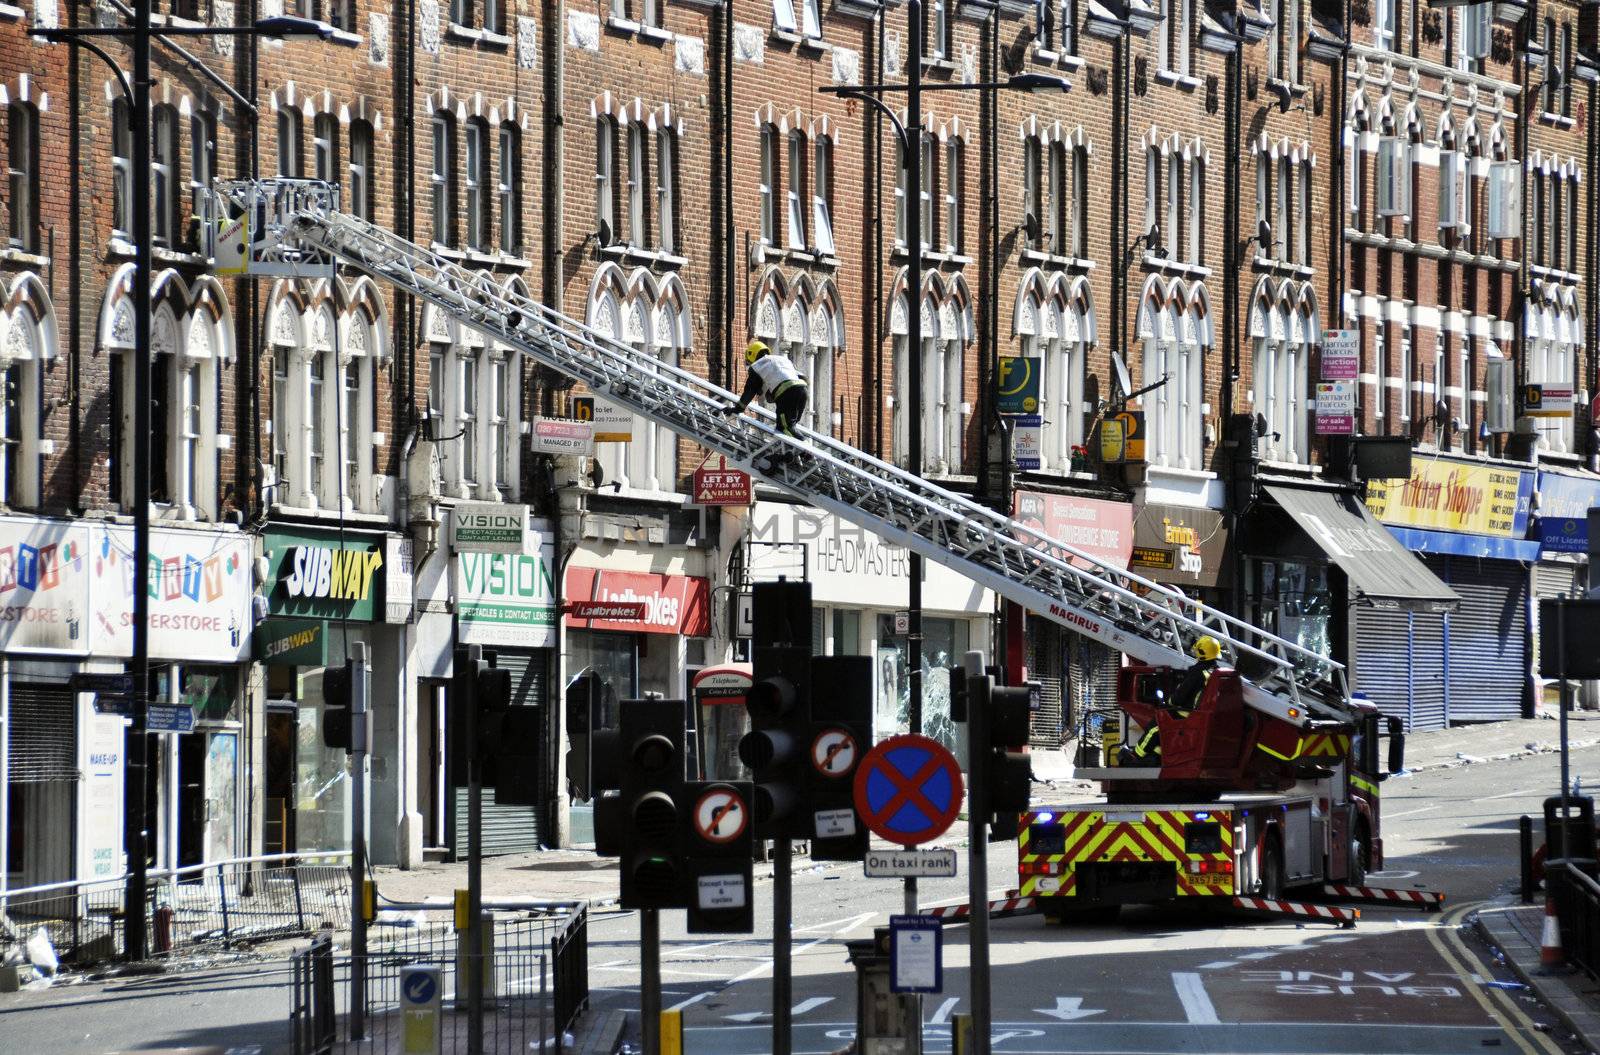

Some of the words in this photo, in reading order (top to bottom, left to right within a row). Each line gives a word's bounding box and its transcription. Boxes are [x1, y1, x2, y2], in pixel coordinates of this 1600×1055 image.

[1401, 467, 1442, 511] Kitchen
[1443, 468, 1484, 524] Shoppe
[458, 515, 522, 527] VISION
[1100, 529, 1120, 549] STORE
[1545, 535, 1560, 544] Off
[1561, 536, 1589, 545] Licenc
[817, 537, 911, 578] HEADMASTERS
[286, 545, 383, 600] SUBWAY
[461, 551, 555, 598] VISION
[0, 606, 60, 624] STORE
[460, 606, 498, 618] SPECTACLES
[505, 608, 531, 619] CONTACT
[534, 610, 555, 621] LENSES
[580, 606, 637, 617] Ladbrokes
[1049, 603, 1102, 634] MAGIRUS
[120, 611, 222, 632] SERSTORE
[263, 626, 321, 659] SUBWAY
[711, 677, 740, 686] Telephone
[90, 752, 118, 766] MAKE-UP
[817, 813, 836, 821] Except
[869, 857, 888, 869] On
[892, 857, 918, 869] taxi
[922, 857, 951, 869] rank
[700, 879, 722, 888] Except
[722, 879, 744, 887] buses
[1240, 970, 1482, 985] LANE
[1275, 984, 1463, 998] BUS
